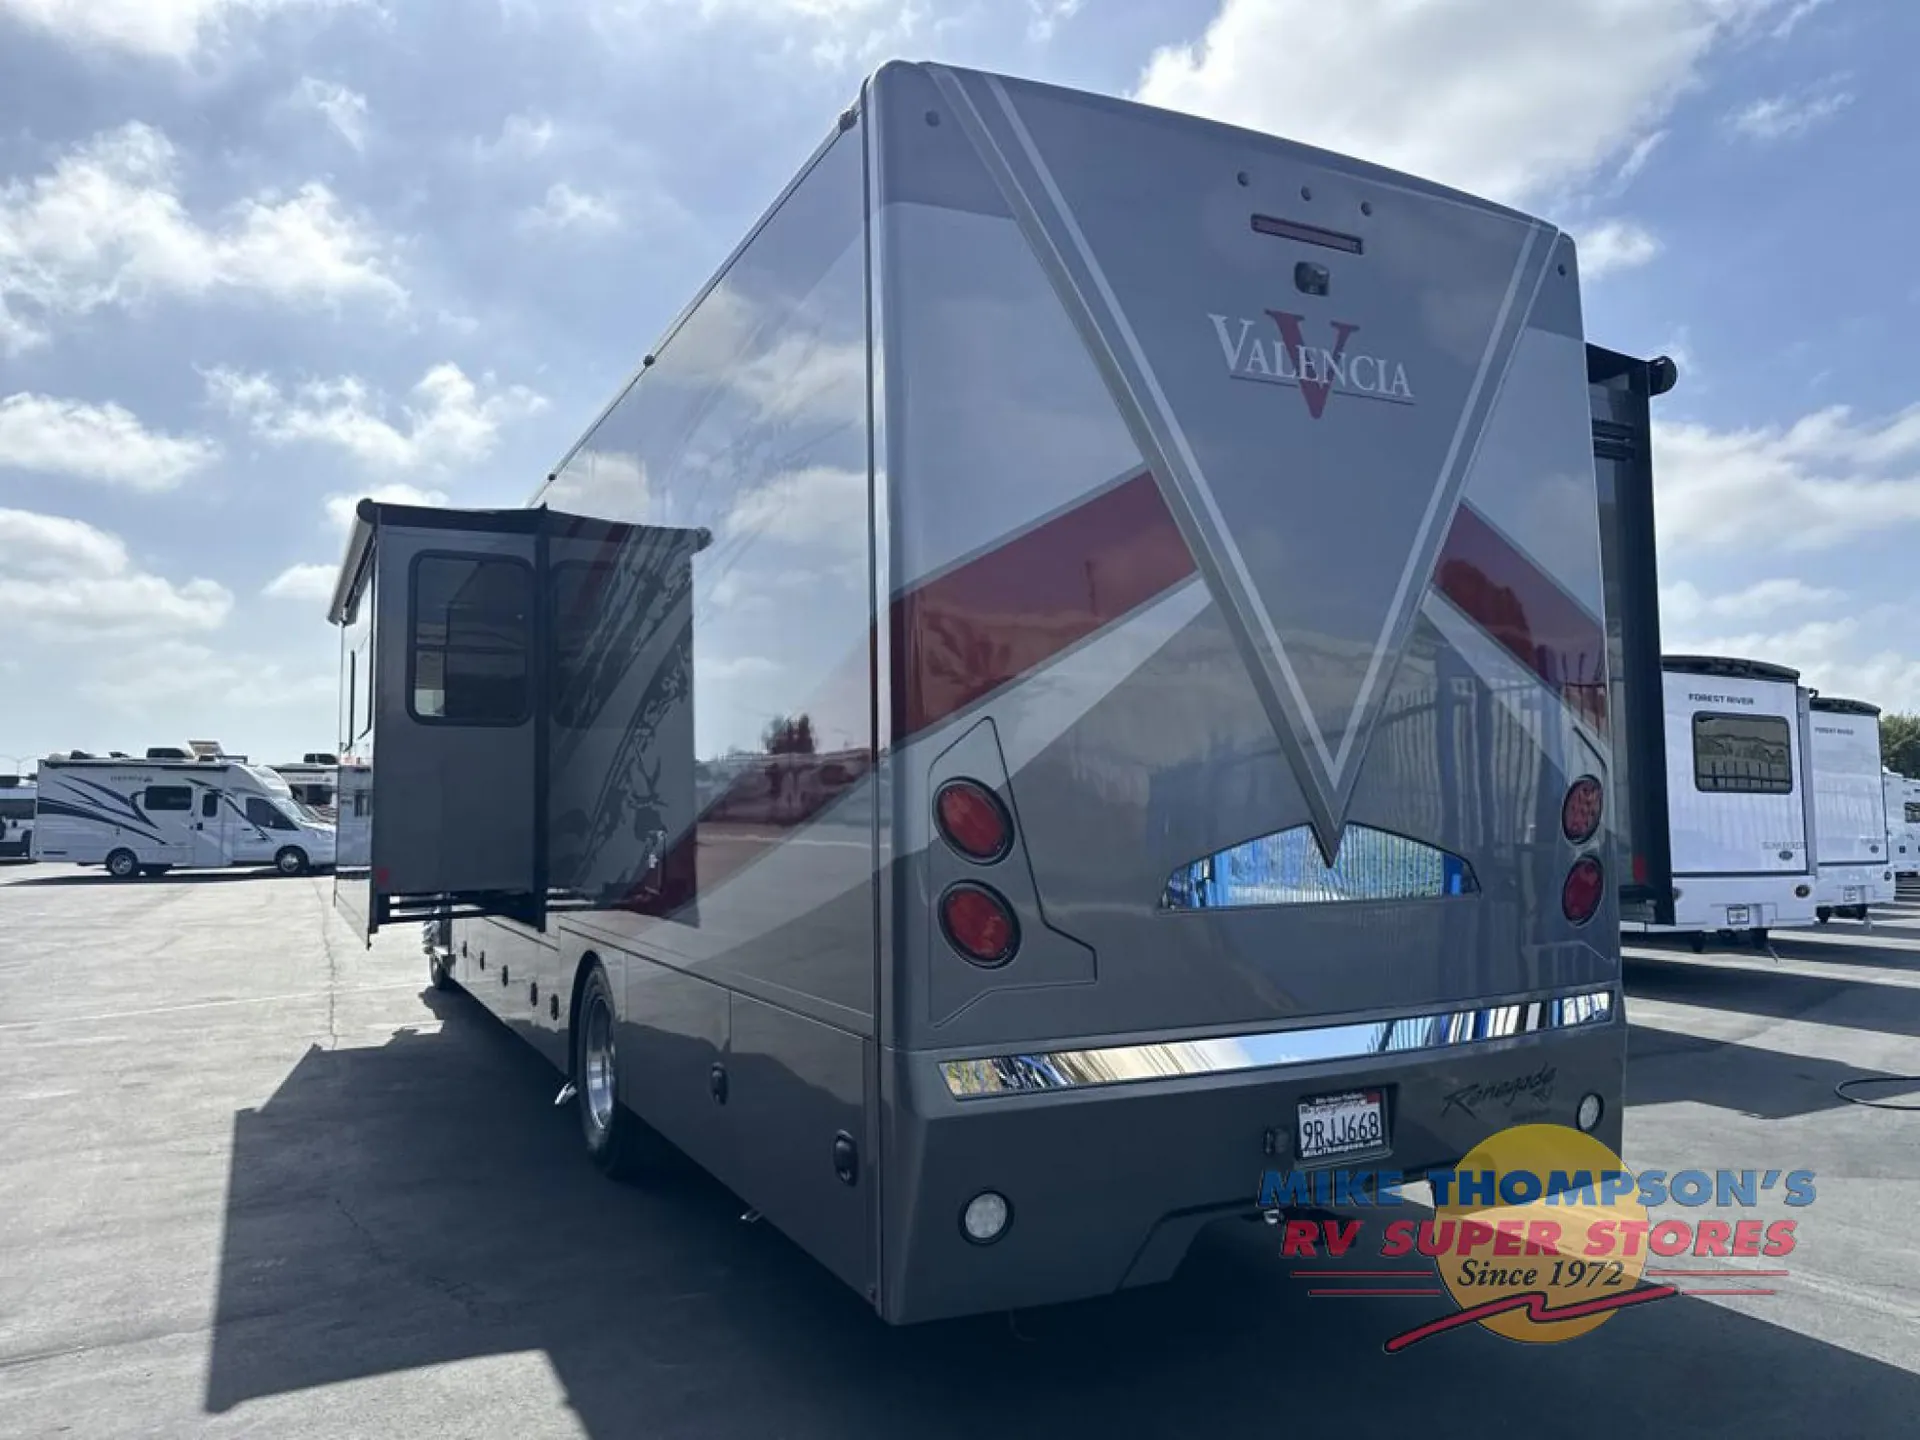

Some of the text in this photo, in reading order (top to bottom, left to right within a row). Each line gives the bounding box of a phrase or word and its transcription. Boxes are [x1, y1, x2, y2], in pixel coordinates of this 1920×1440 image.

[1207, 312, 1415, 398] VALENCIA
[1688, 693, 1754, 706] FOREST RIVER
[1440, 1061, 1558, 1120] Renegade
[1302, 1111, 1379, 1153] 9RJJ668
